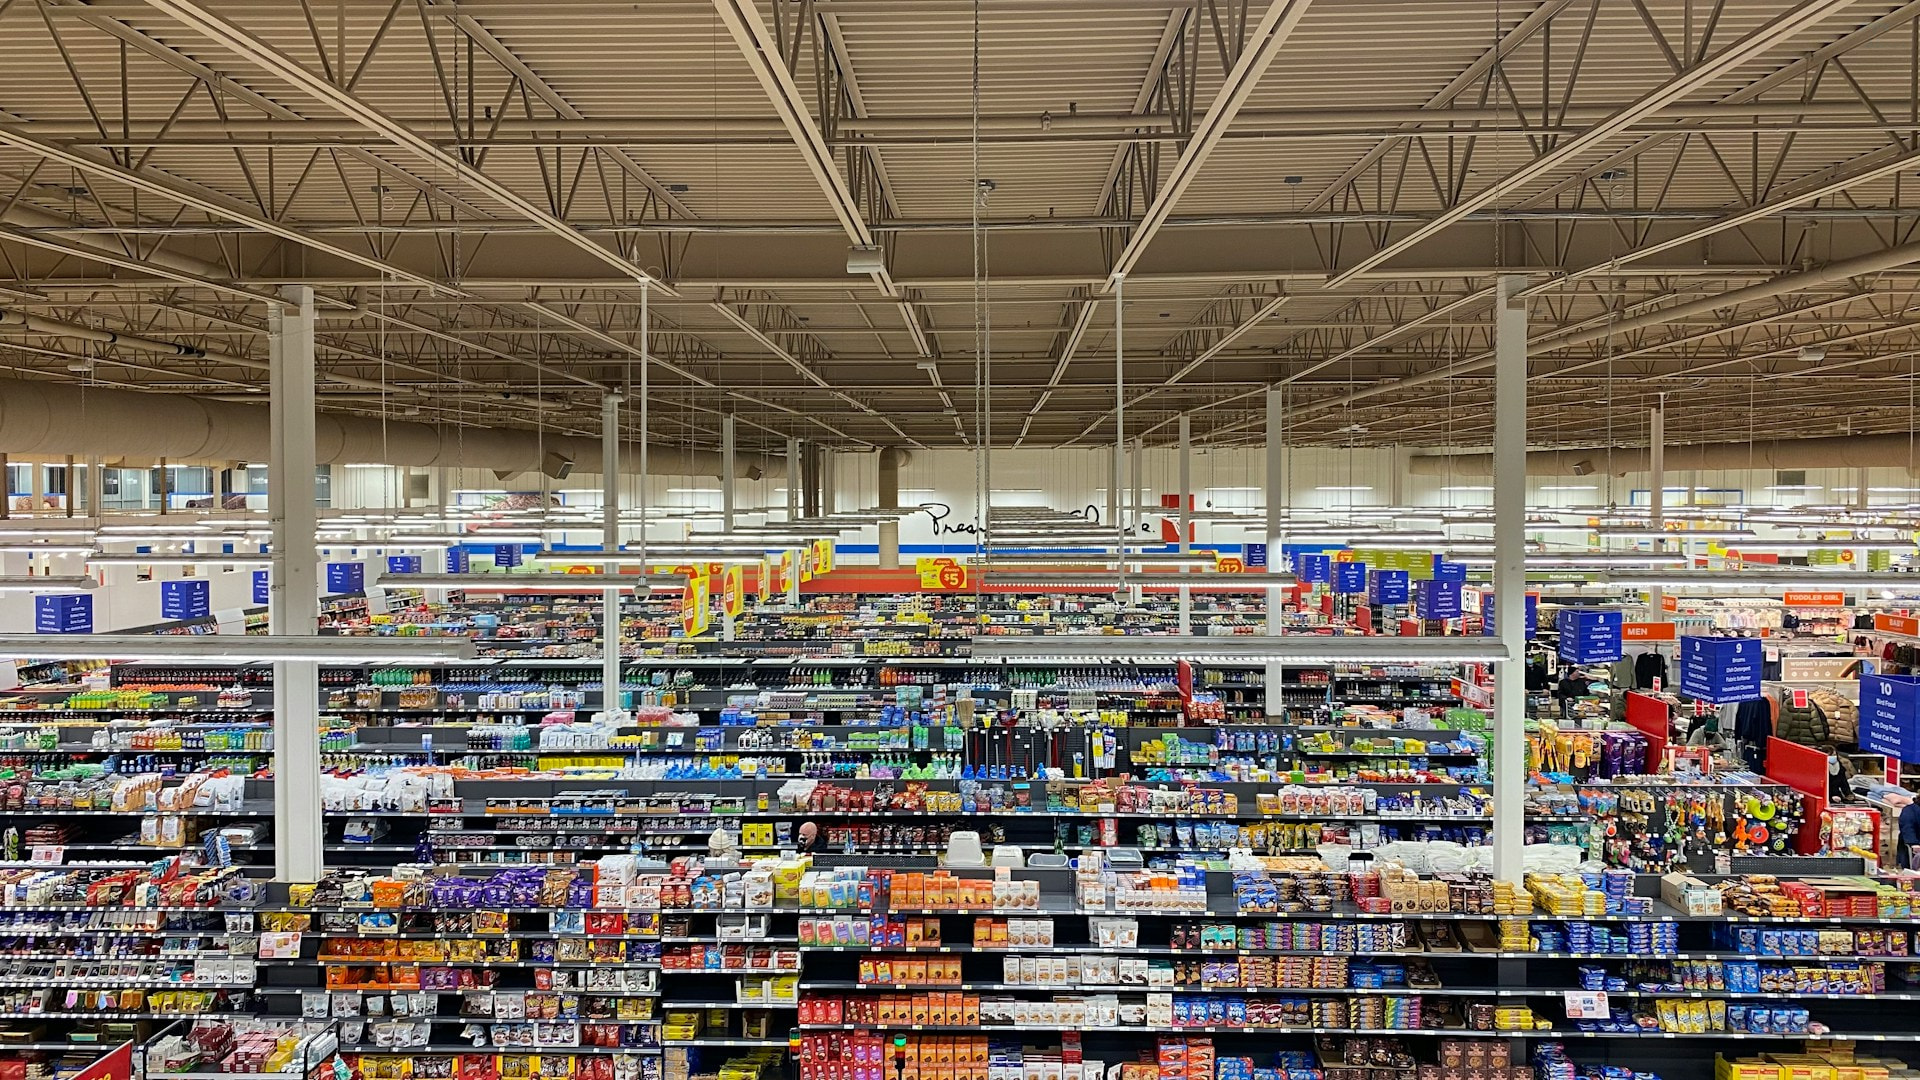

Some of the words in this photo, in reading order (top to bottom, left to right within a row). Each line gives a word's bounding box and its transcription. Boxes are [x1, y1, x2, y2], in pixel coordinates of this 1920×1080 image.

[944, 573, 959, 586] $5
[1598, 615, 1604, 624] 8
[1889, 618, 1904, 627] BABY
[1695, 641, 1700, 651] 9
[1736, 643, 1742, 653] 9
[1880, 682, 1892, 695] 10
[1876, 698, 1885, 706] Bird
[1886, 700, 1896, 708] Food
[1885, 712, 1896, 720] Litter
[1872, 720, 1880, 728] Dry
[1880, 722, 1888, 731] Dog
[1889, 725, 1900, 733] Food
[1871, 731, 1881, 739] Moist
[1890, 736, 1901, 745] Food
[1877, 744, 1901, 756] Accessories
